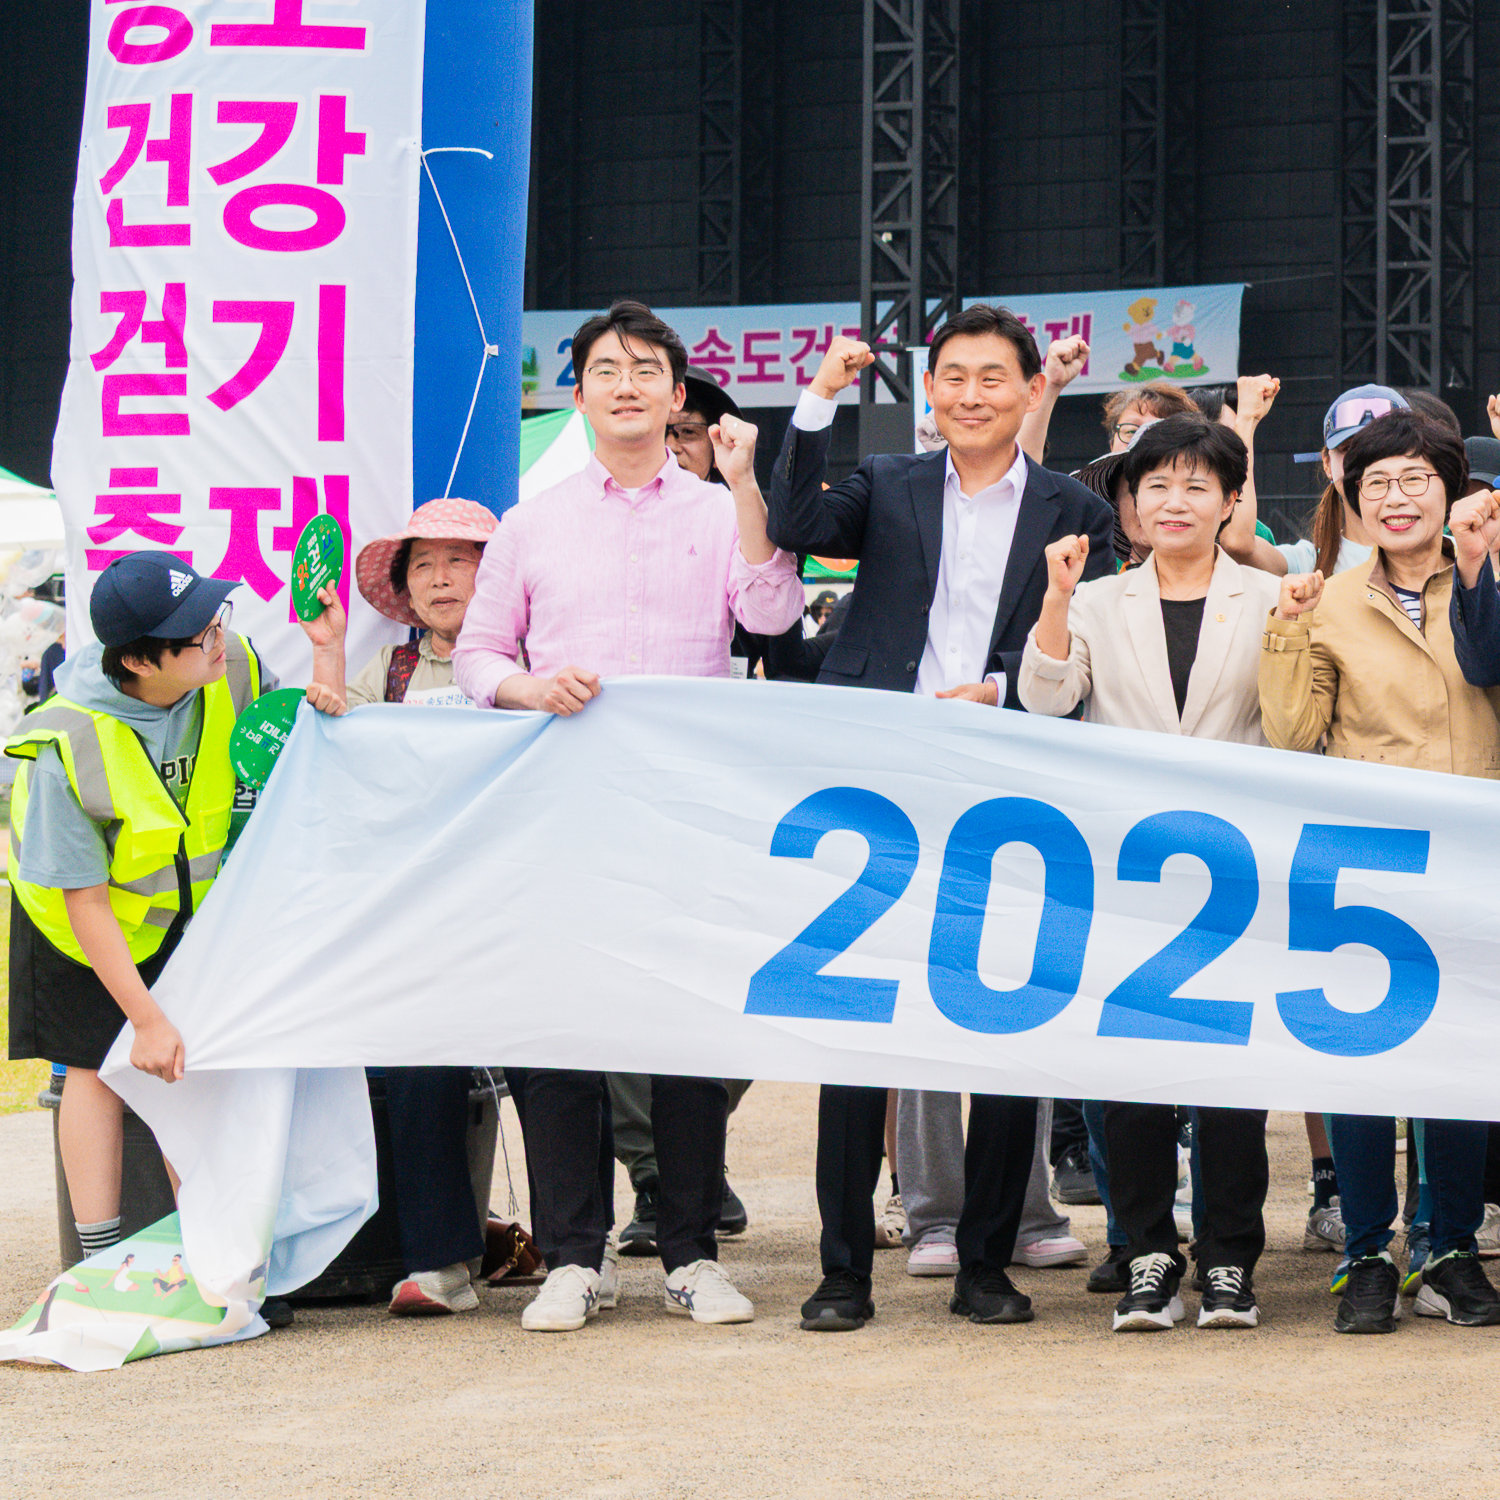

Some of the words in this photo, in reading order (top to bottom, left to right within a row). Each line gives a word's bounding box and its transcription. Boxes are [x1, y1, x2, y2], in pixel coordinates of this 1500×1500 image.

[100, 94, 367, 253] 건강
[90, 282, 347, 442] 걷기
[744, 786, 1440, 1057] 2025
